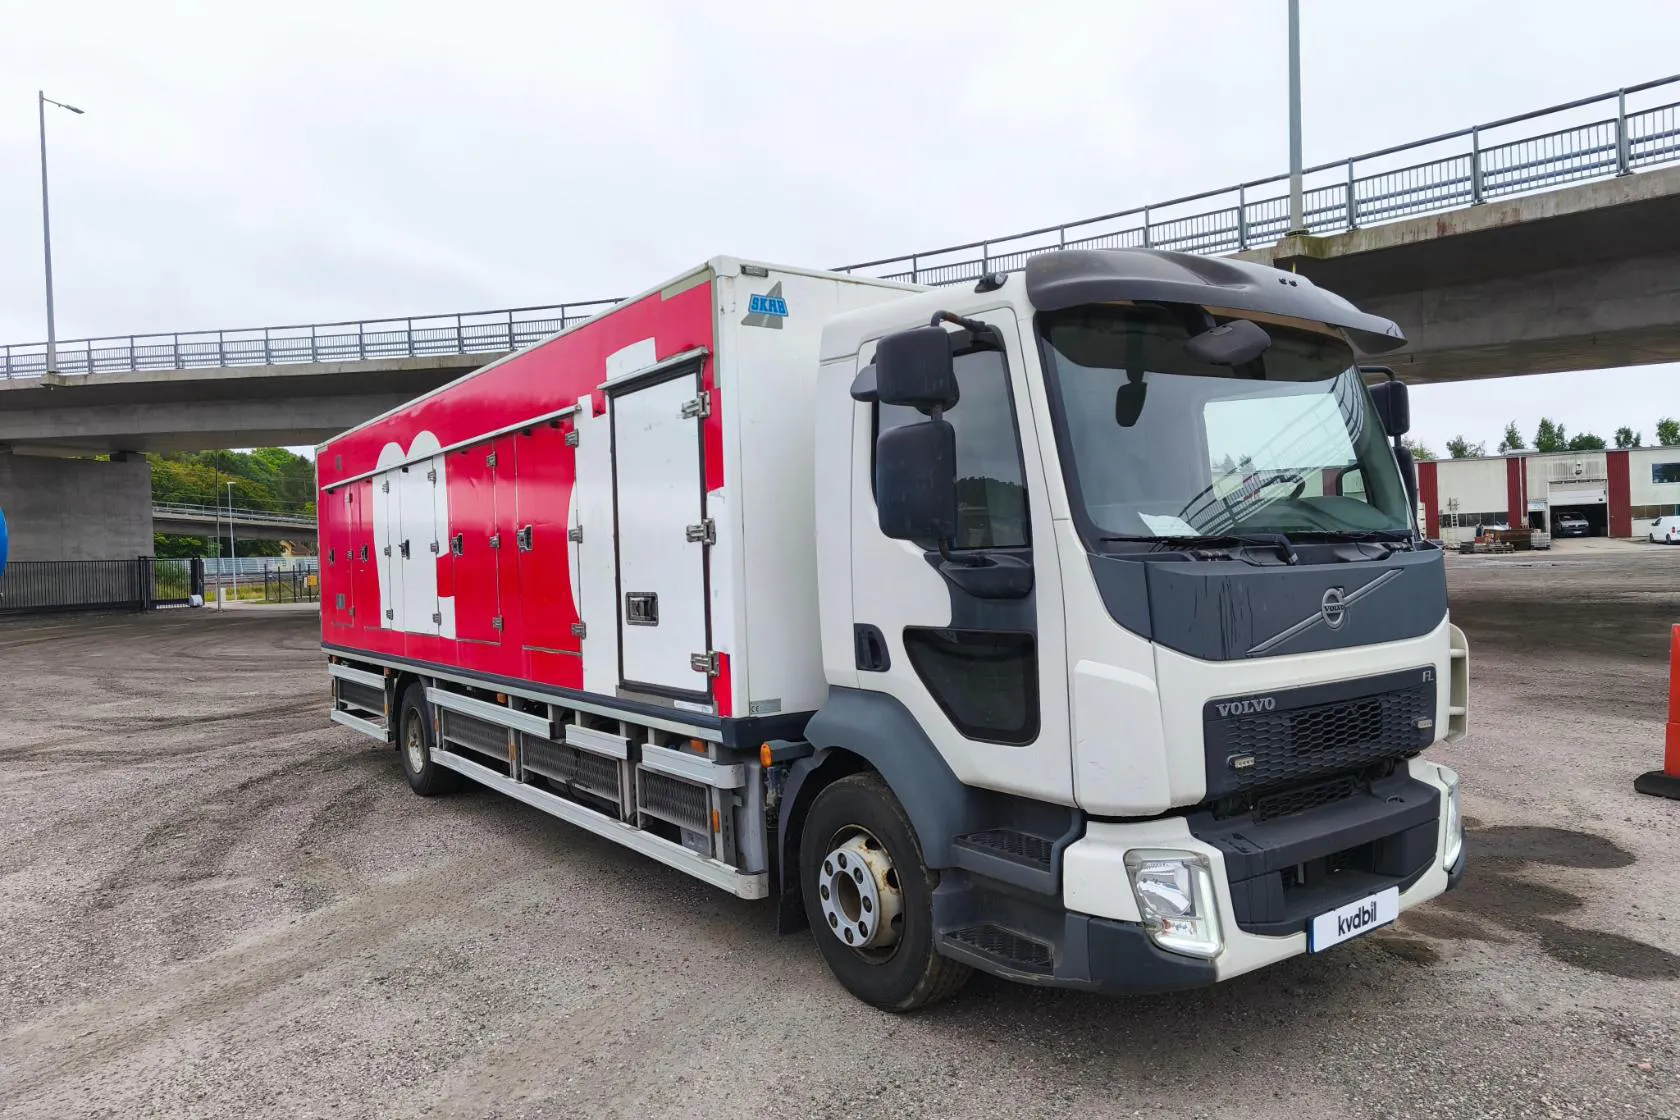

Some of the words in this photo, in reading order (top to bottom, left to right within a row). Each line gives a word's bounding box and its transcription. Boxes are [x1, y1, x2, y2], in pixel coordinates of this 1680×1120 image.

[751, 295, 786, 314] SKAB
[1422, 670, 1434, 682] FL
[751, 705, 760, 713] CE
[1216, 697, 1276, 717] VOLVO
[1338, 901, 1377, 937] kvdbil
